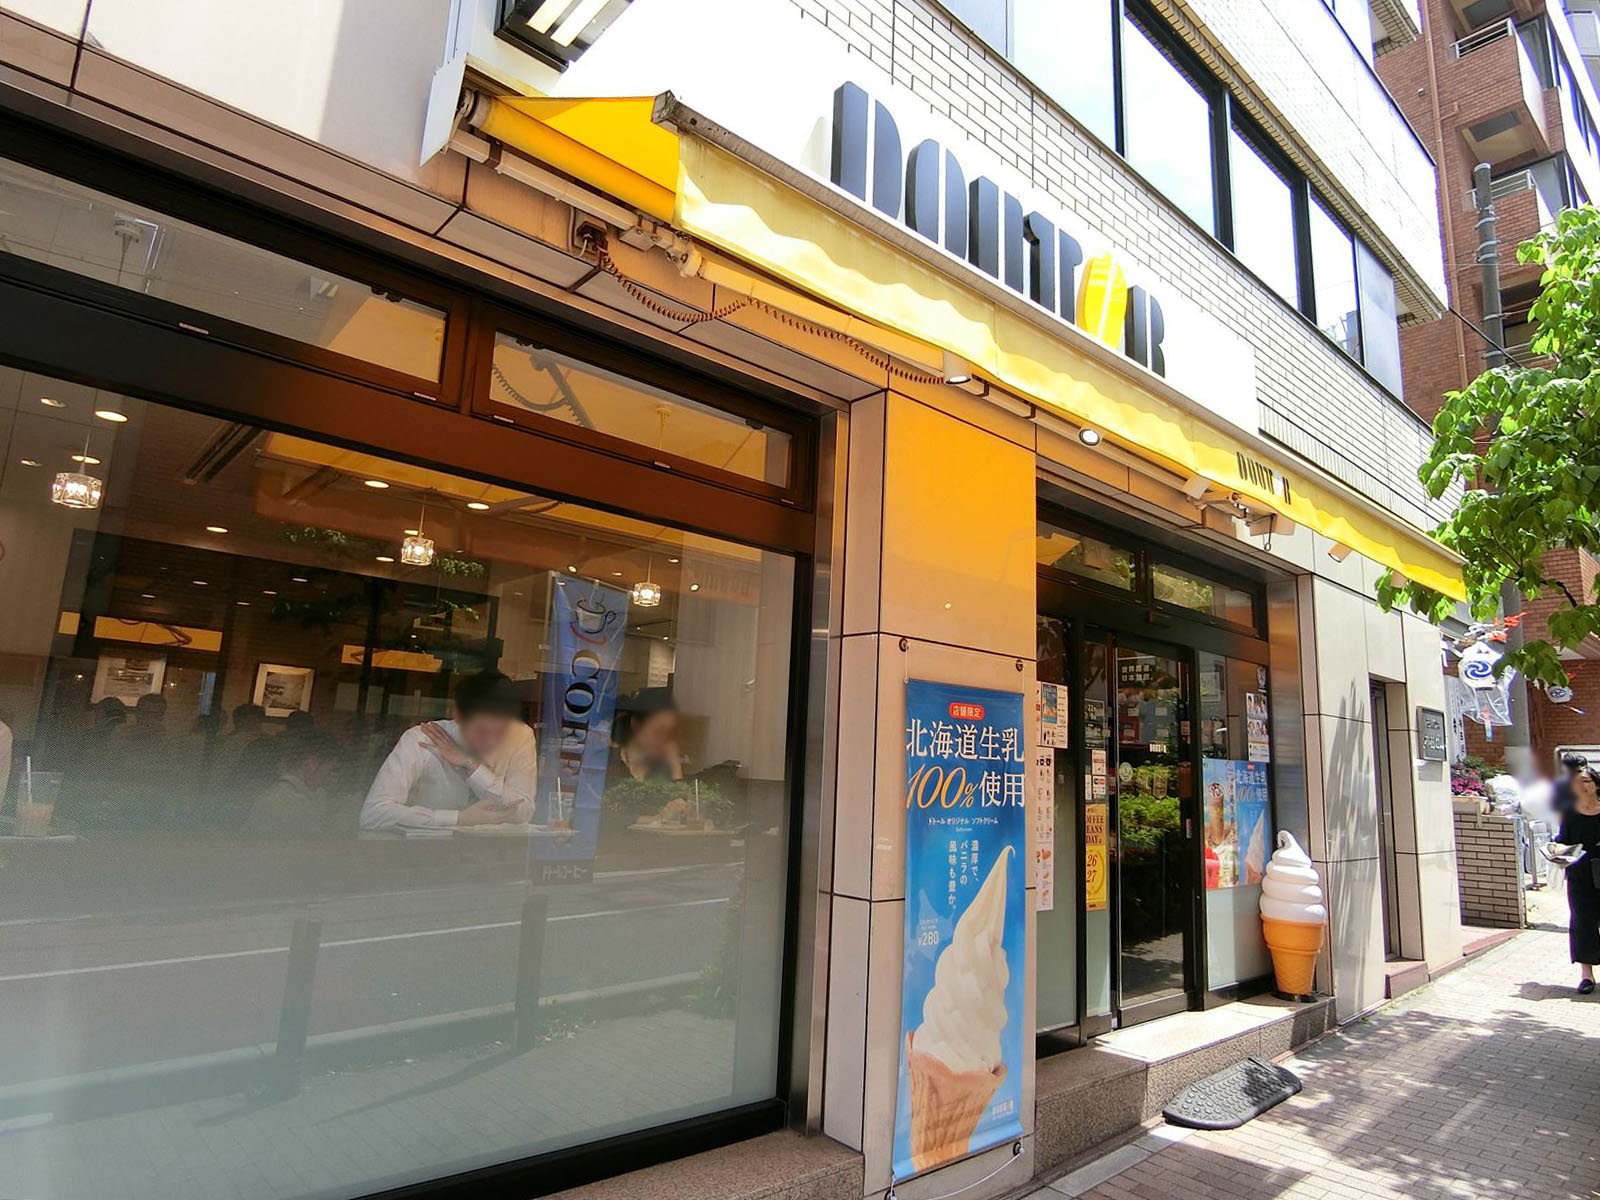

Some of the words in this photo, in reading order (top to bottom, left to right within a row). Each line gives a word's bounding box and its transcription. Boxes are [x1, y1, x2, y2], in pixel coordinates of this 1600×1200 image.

[952, 705, 981, 719] 店舗限定
[905, 718, 1025, 763] 北海道生乳
[959, 840, 969, 885] バニラの
[1087, 855, 1098, 867] 26
[1086, 870, 1098, 883] 27
